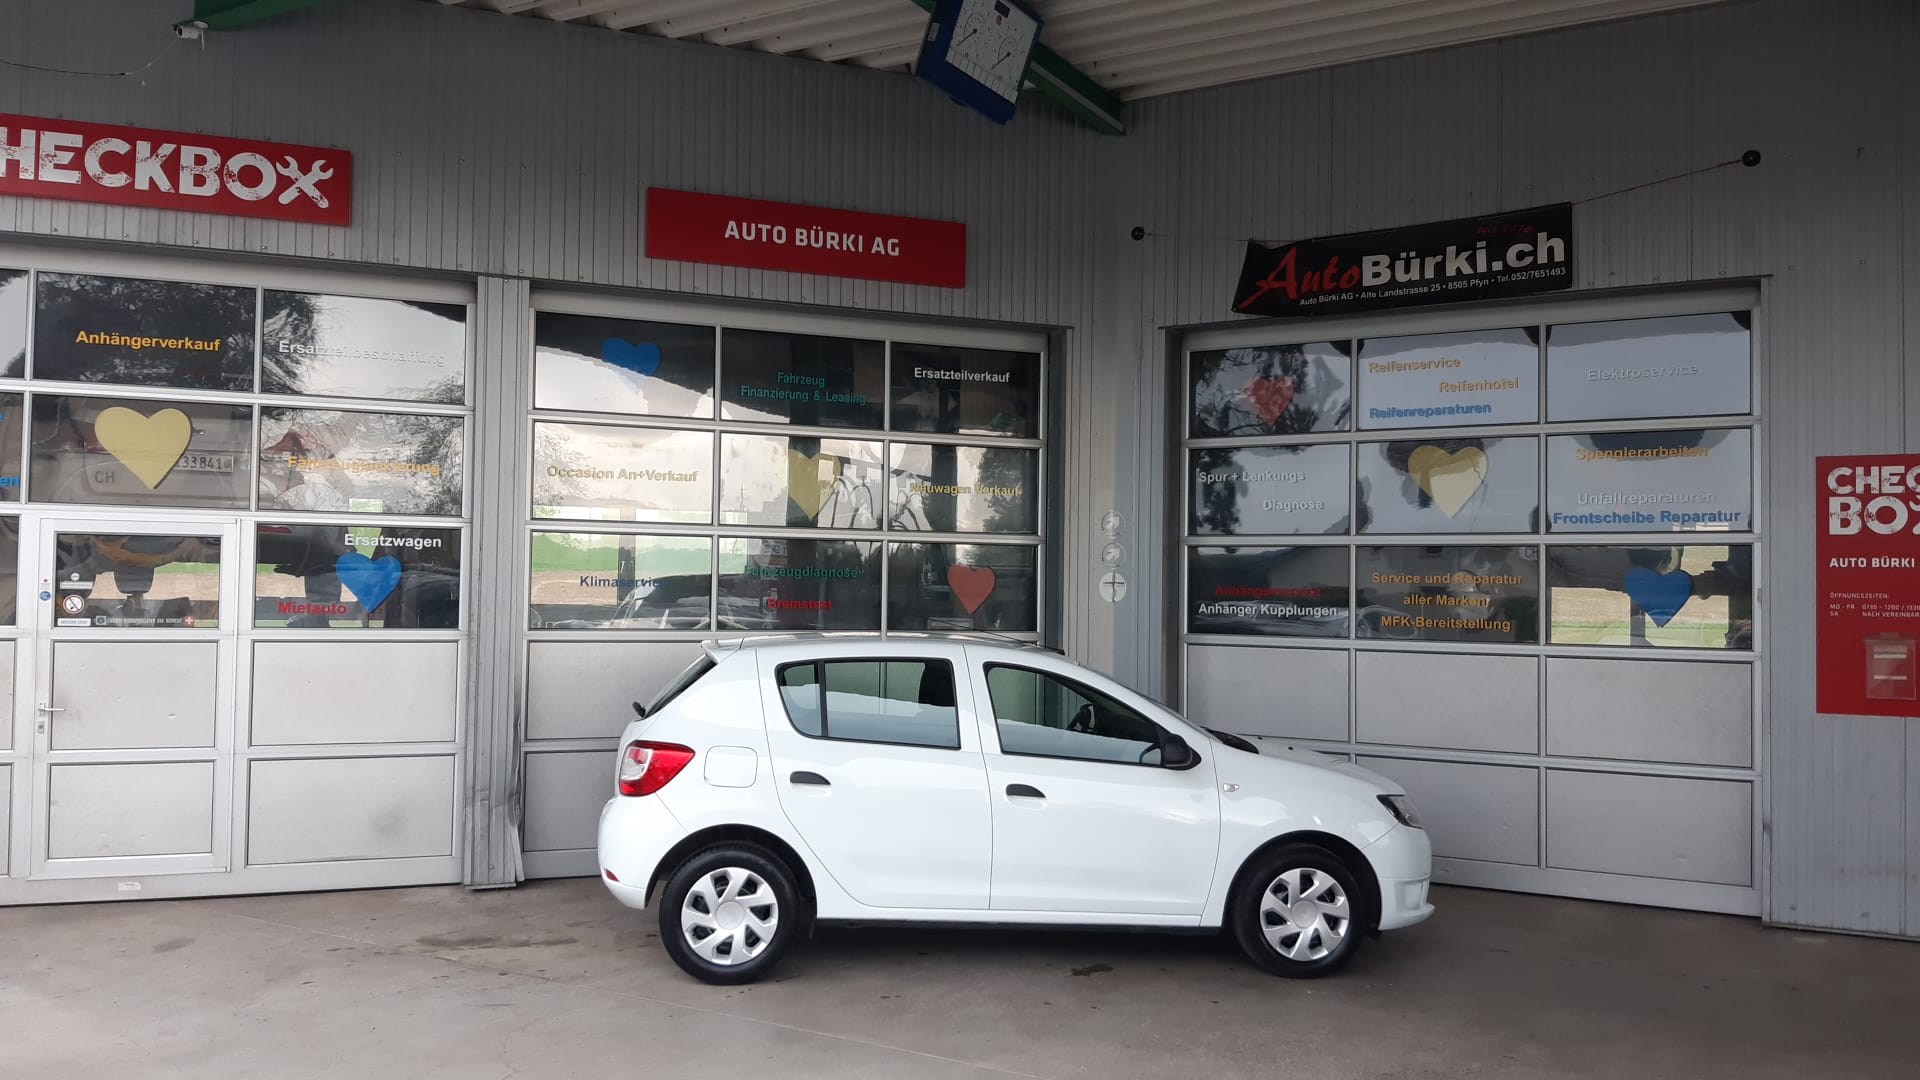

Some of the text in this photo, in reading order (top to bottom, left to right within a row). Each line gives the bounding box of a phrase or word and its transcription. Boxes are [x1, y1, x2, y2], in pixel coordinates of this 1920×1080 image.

[724, 220, 900, 257] AUTO BÜRKI AG
[1299, 266, 1566, 306] Auto Bürki AG Alte Landstrasse 25 8505 Pfyn Tel.052/7651493
[76, 330, 220, 352] Anhängerverkauf
[1369, 356, 1461, 373] Reifenservice
[1586, 363, 1698, 381] Elektroservice
[777, 371, 825, 387] Fahrzeug
[914, 367, 1010, 384] Ersatzteilverkauf
[1438, 377, 1519, 392] Reifenhotel
[740, 385, 867, 407] Finanzierung & Leasing
[1369, 402, 1491, 420] Reifenreparaturen
[1576, 445, 1708, 462] Spenglerarbeiten
[176, 455, 222, 469] 33841
[94, 471, 115, 484] CH
[546, 464, 699, 483] Occasion An+Verkauf
[1199, 470, 1305, 483] Spur + Lenkungs
[975, 485, 1021, 496] Verkauf
[1577, 490, 1716, 506] Unfallreparaturen
[1263, 499, 1324, 512] Diagnose
[1553, 510, 1740, 525] Frontscheibe Reparatur
[344, 534, 442, 550] Ersatzwagen
[1829, 555, 1915, 568] AUTO BÜRKI
[745, 565, 858, 580] Fahrzeugdiagnose
[1371, 572, 1522, 587] Service und Reparatur
[579, 574, 668, 590] Klimaservice
[767, 598, 832, 610] Bremstest
[1403, 593, 1488, 607] aller Marken
[277, 601, 347, 616] Mietauto
[1198, 604, 1337, 618] Anhänger Kupplungen
[1381, 616, 1511, 632] MFK-Bereitstellung
